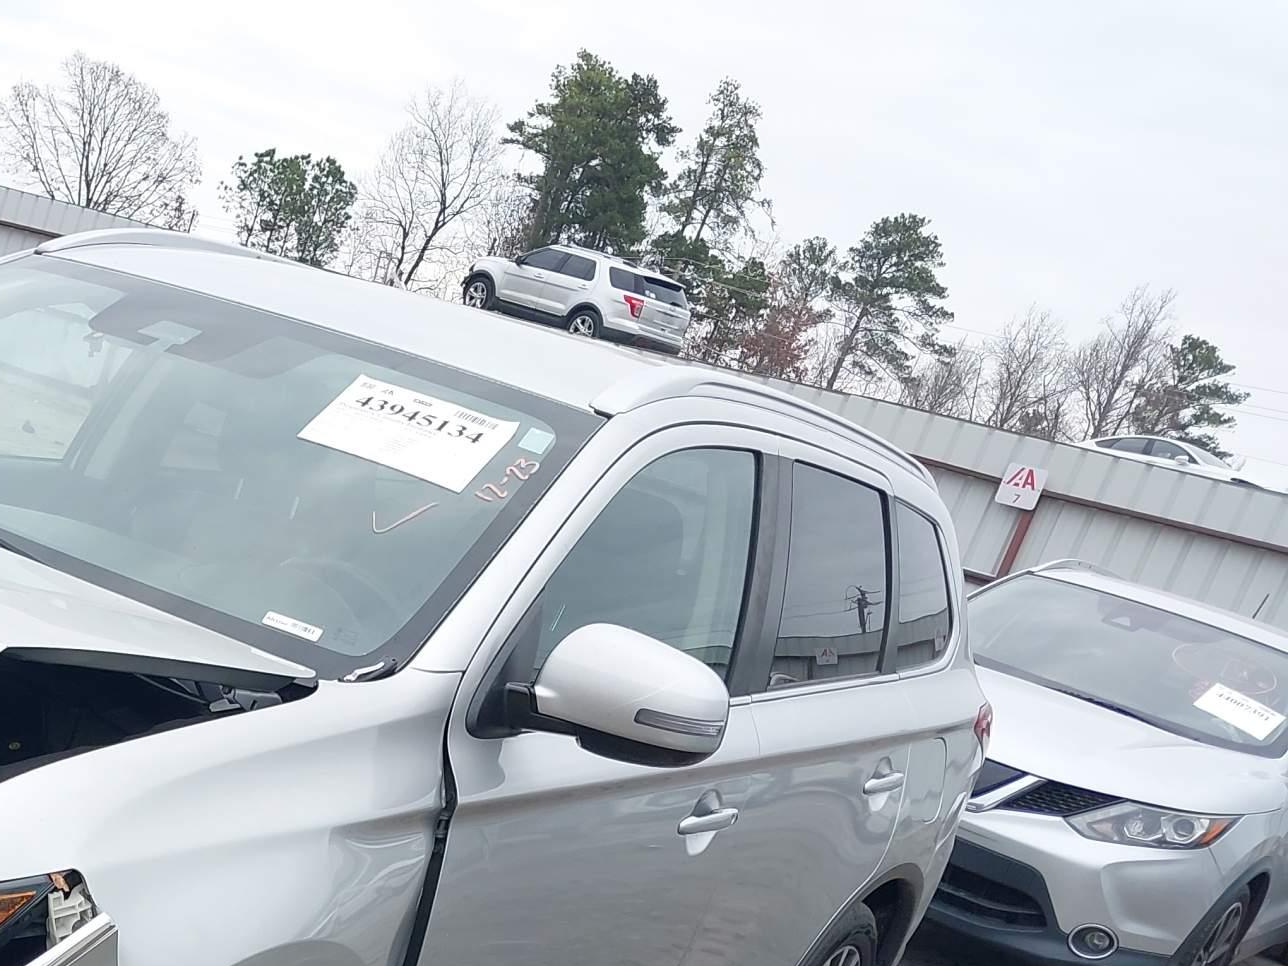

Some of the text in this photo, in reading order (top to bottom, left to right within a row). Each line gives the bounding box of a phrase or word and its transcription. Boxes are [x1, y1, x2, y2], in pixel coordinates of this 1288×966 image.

[355, 396, 484, 444] 43945134
[475, 458, 540, 502] 12-23
[1012, 493, 1021, 504] 7
